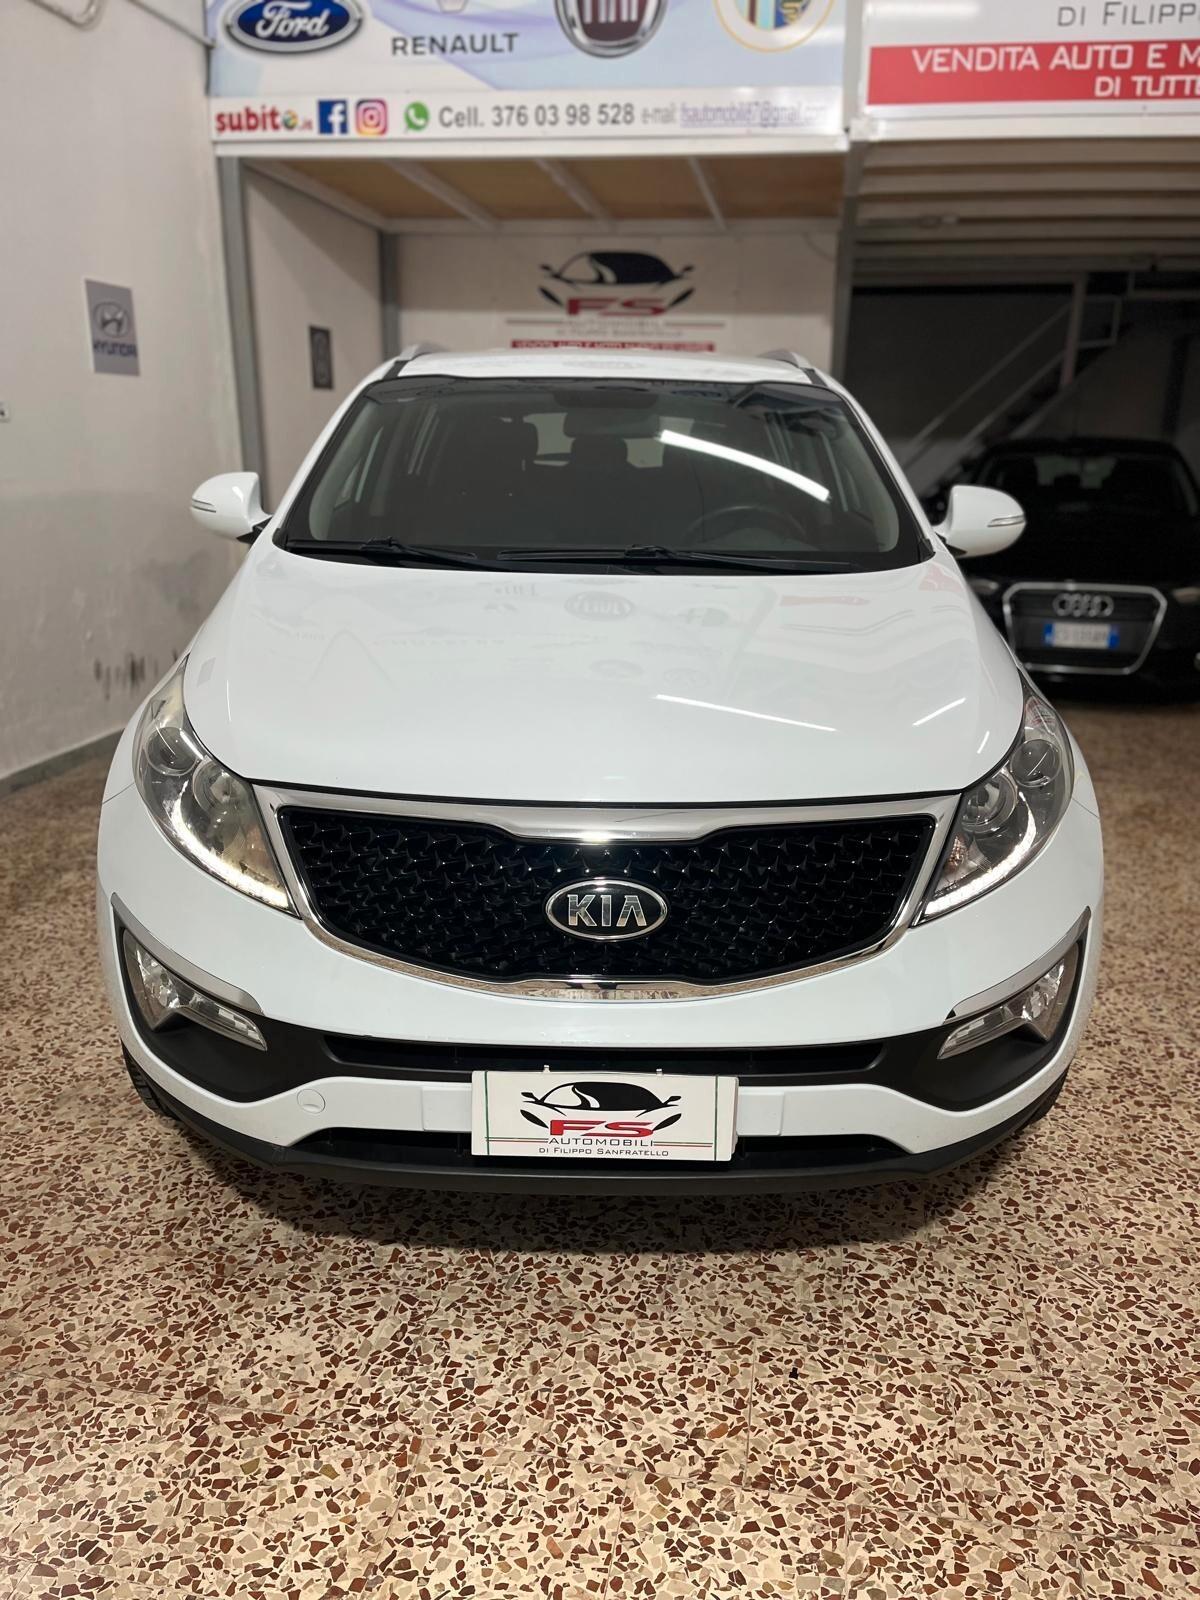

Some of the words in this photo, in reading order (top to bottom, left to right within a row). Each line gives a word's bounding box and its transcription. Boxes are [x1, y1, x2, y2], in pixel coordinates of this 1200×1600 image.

[254, 0, 331, 38] Ford
[1056, 6, 1085, 27] DI
[1102, 1, 1200, 27] FILIPP
[391, 34, 519, 55] RENAULT
[912, 47, 1040, 73] VENDITA
[1048, 44, 1134, 71] AUTO
[1146, 43, 1168, 69] E
[1094, 76, 1121, 97] DI
[438, 106, 485, 128] Cell.
[491, 105, 529, 127] 376
[534, 105, 560, 126] 03
[565, 104, 591, 126] 98
[597, 103, 635, 125] 528
[567, 298, 666, 316] FS
[567, 894, 647, 927] KIA
[550, 1120, 654, 1138] FS
[549, 1137, 654, 1147] AUTOMOBILI
[553, 1147, 592, 1155] FILIPPO
[596, 1149, 669, 1157] SANFRATELLO
